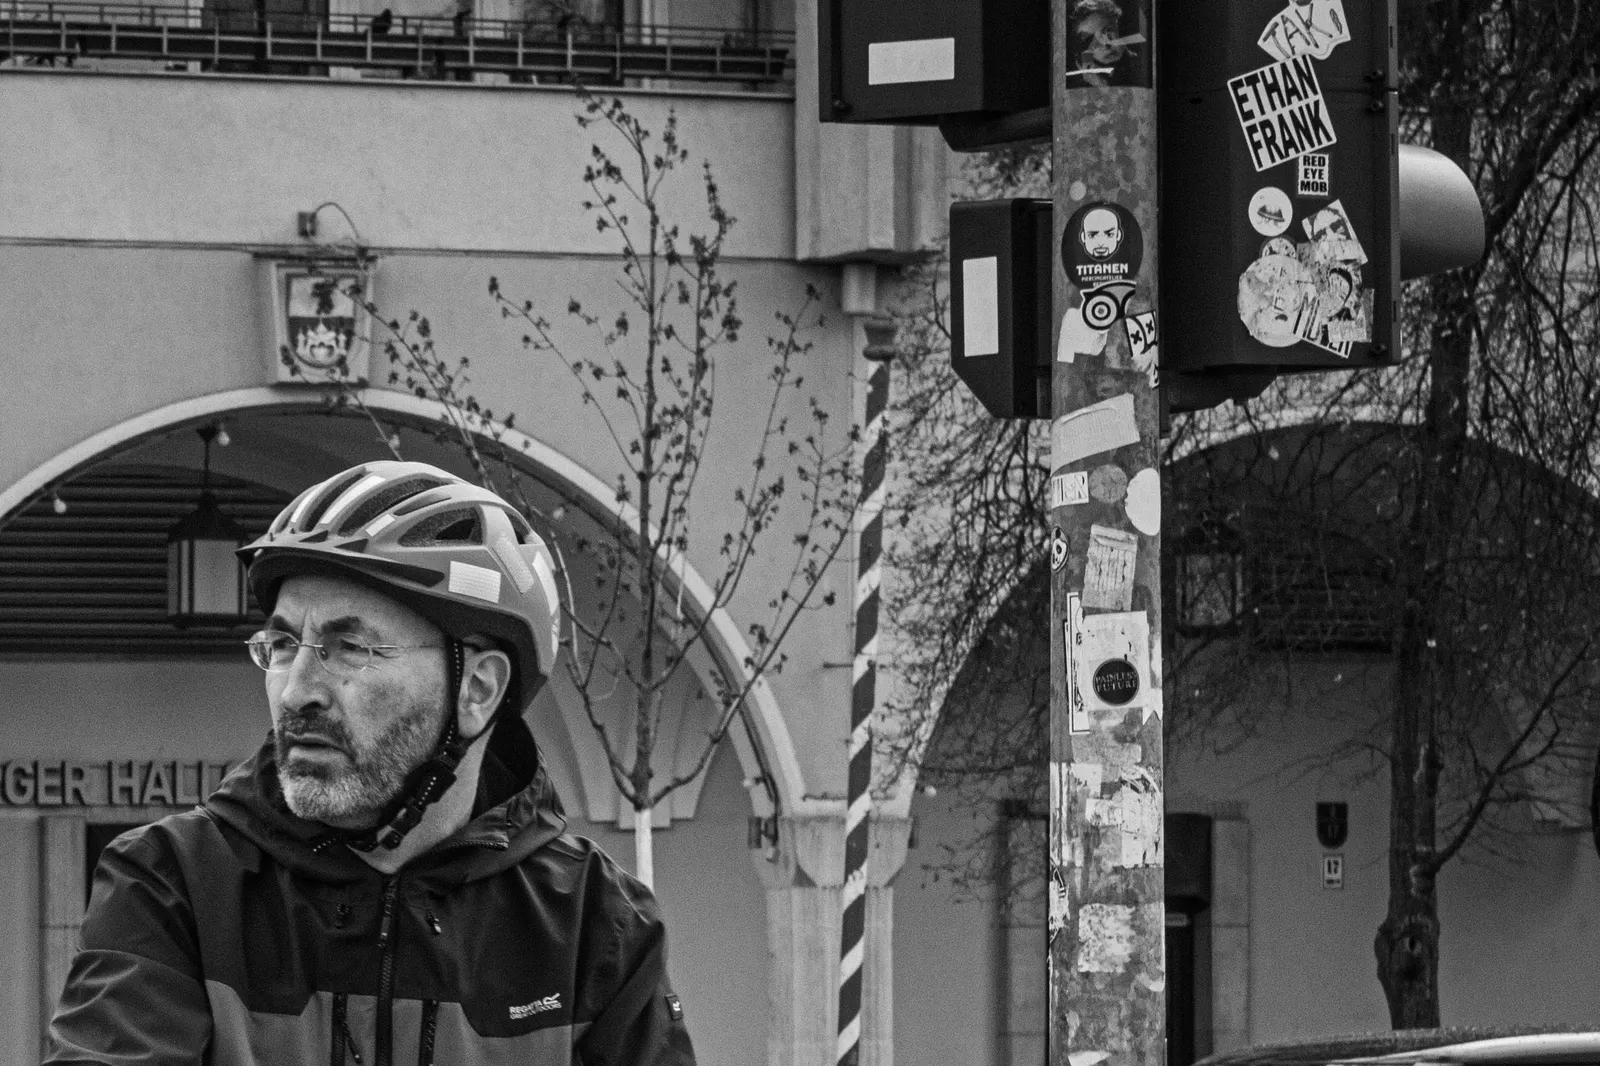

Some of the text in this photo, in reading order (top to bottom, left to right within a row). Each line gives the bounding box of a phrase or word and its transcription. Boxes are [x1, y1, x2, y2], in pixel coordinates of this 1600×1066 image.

[1230, 54, 1318, 123] ETHAN
[1246, 99, 1333, 169] FRANK
[1303, 155, 1326, 167] RED
[1304, 168, 1325, 180] EYE
[1300, 180, 1327, 193] MOB
[1076, 263, 1128, 275] TITANEN
[112, 760, 232, 806] HALL
